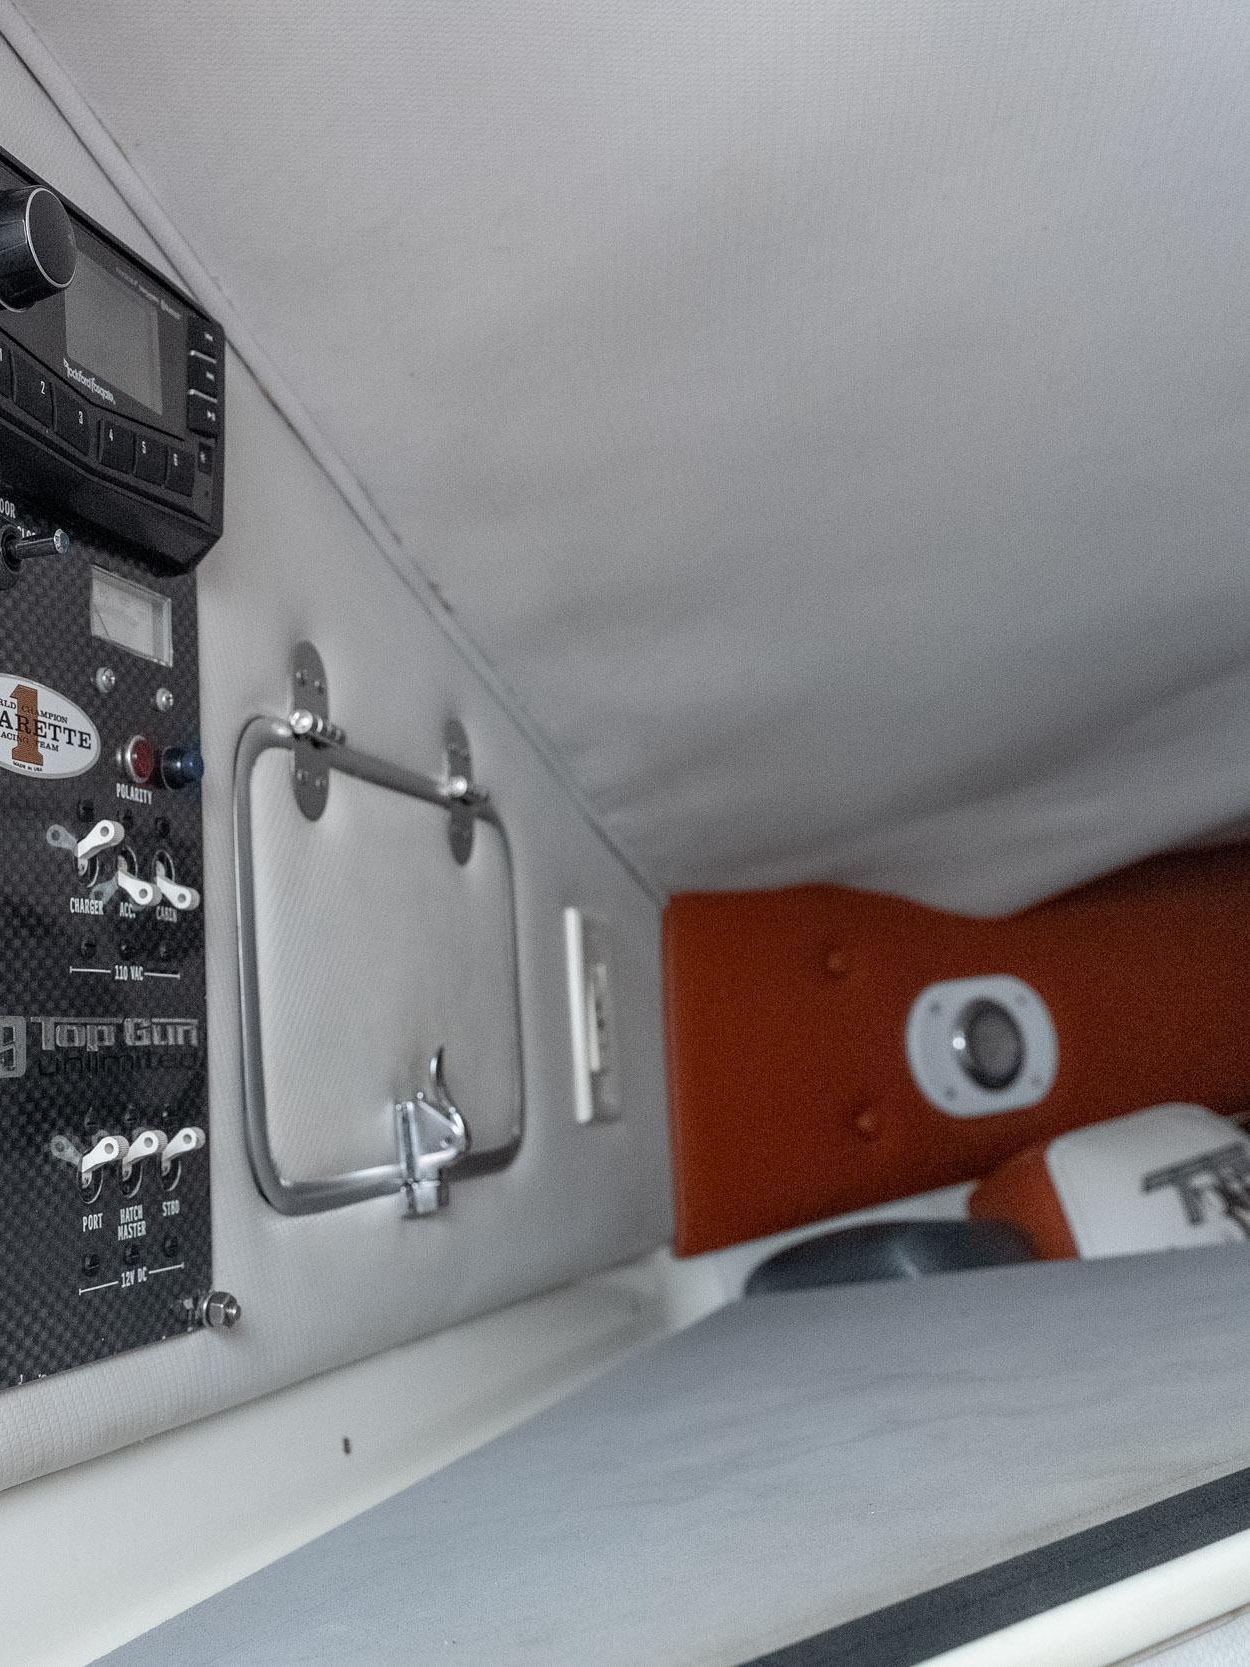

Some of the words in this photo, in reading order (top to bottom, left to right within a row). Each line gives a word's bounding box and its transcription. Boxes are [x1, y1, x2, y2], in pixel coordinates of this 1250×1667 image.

[40, 380, 46, 394] 2
[78, 410, 84, 425] 3
[108, 428, 114, 442] 4
[141, 440, 147, 454] 5
[0, 498, 16, 519] OOR
[21, 705, 68, 724] CHAMPION
[37, 740, 59, 752] TEAM
[116, 783, 152, 805] POLARITY
[69, 897, 104, 915] CHARGER
[119, 902, 136, 918] ACC.
[114, 965, 128, 980] 110
[130, 966, 144, 981] VAC
[30, 1016, 123, 1051] Top
[123, 1017, 199, 1047] Gun
[82, 1213, 103, 1232] PORT
[119, 1204, 143, 1225] HATCH
[117, 1220, 147, 1241] MASTER
[121, 1271, 135, 1288] 12V
[138, 1266, 148, 1283] DC
